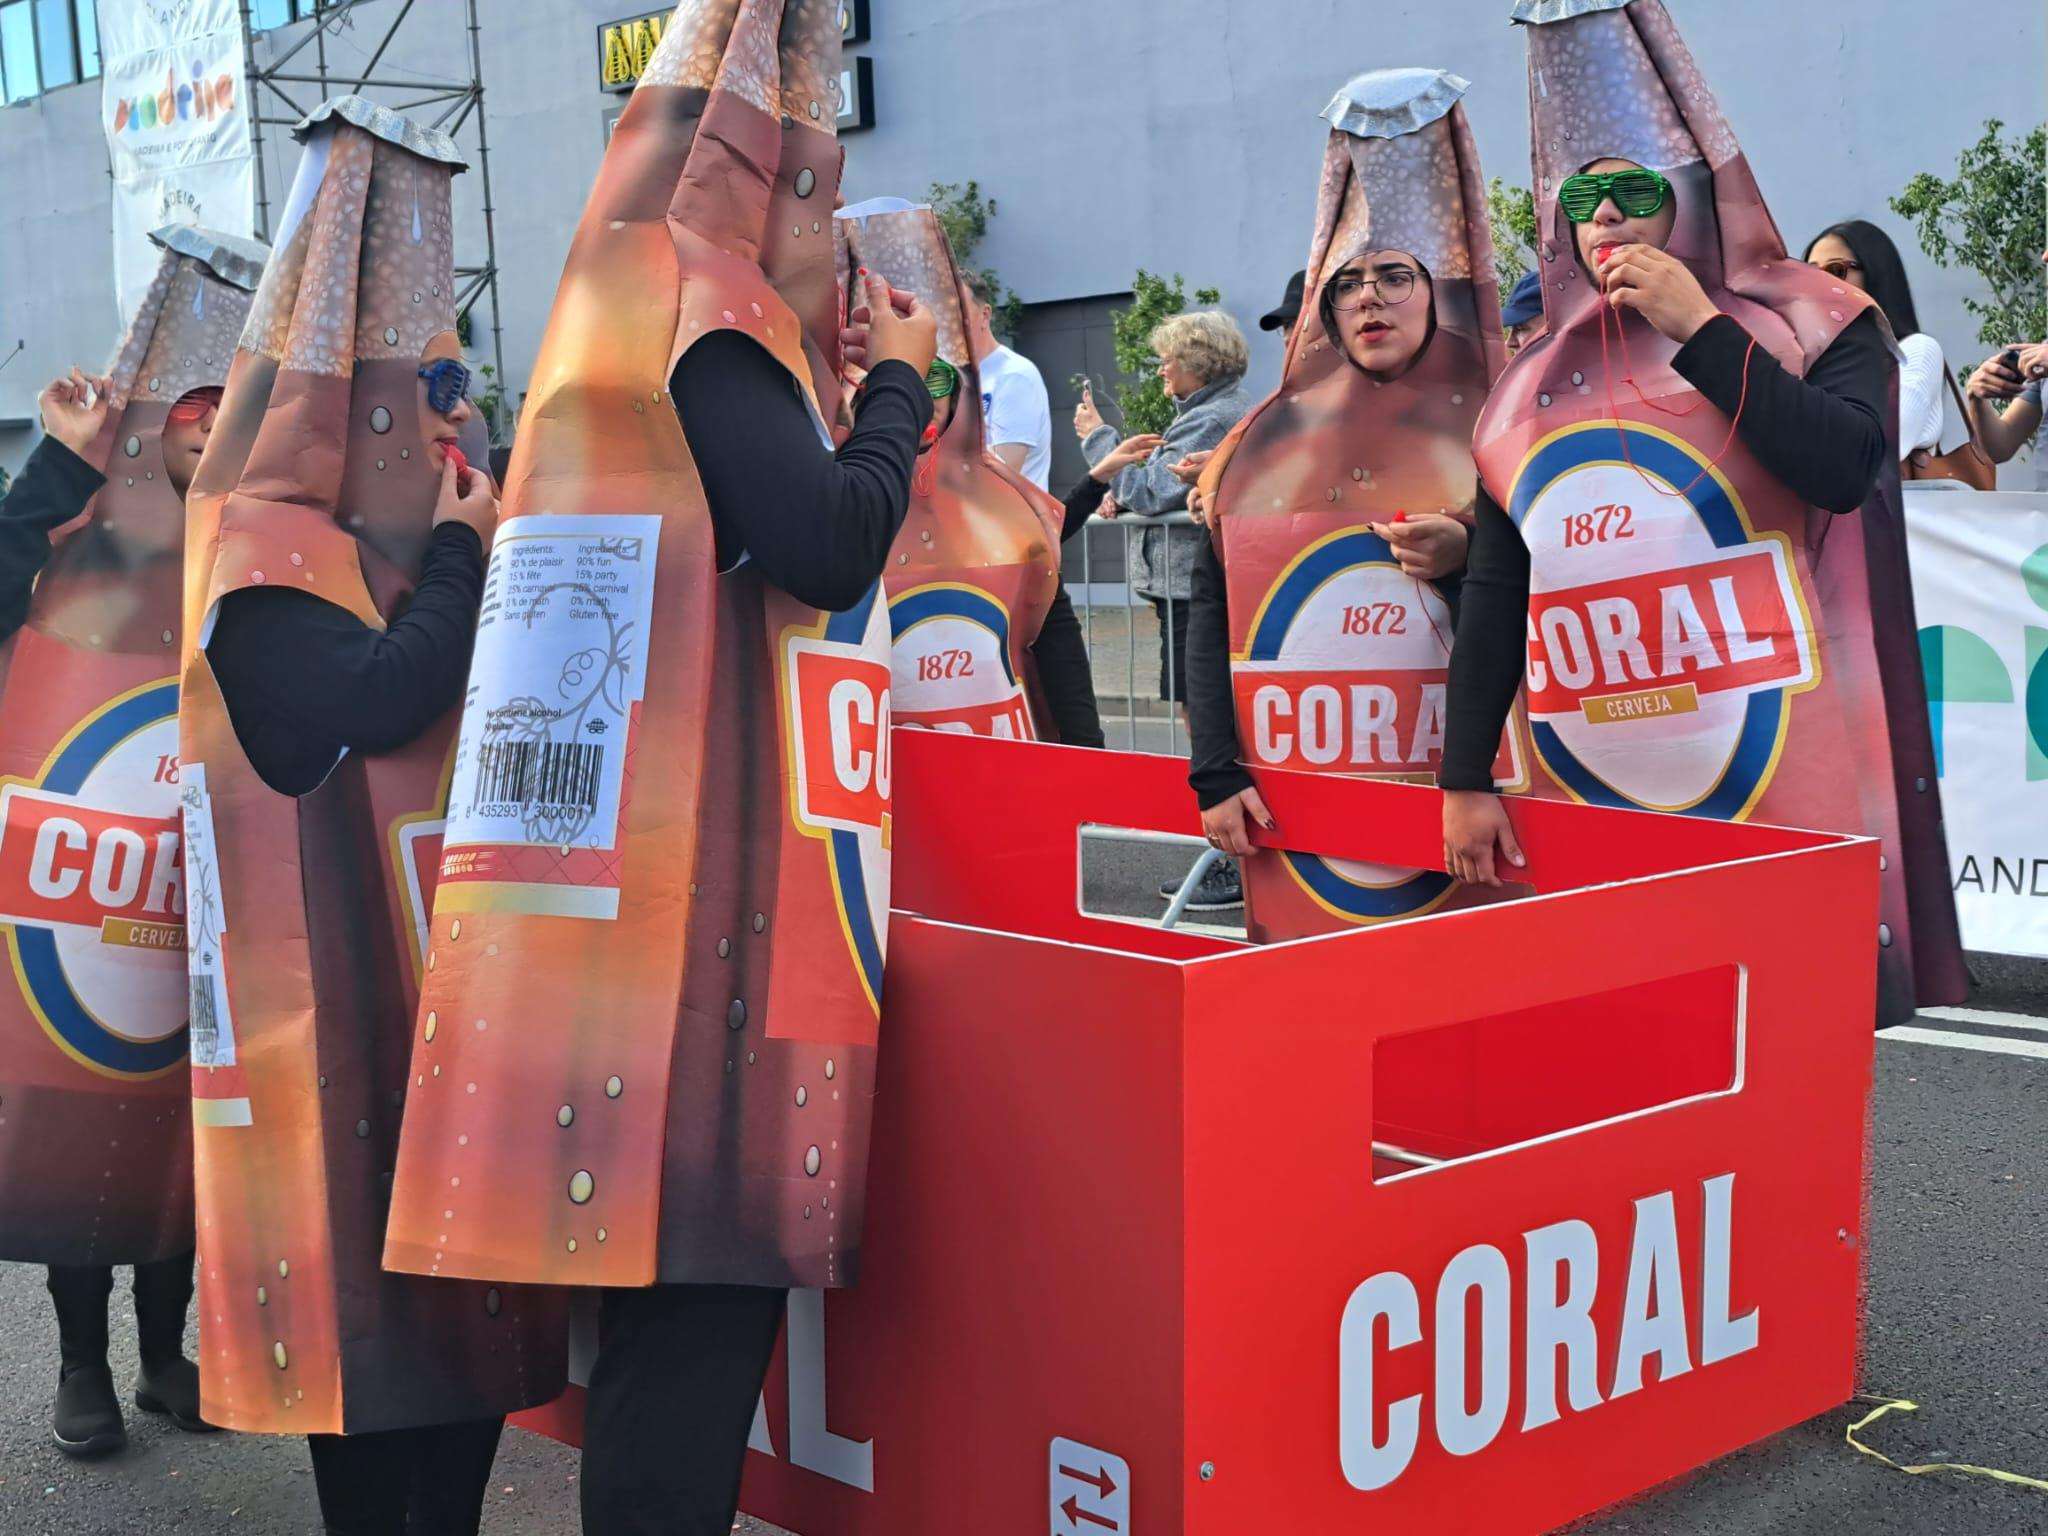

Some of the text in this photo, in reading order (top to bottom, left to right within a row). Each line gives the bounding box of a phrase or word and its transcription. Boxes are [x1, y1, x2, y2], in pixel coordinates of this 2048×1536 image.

[1561, 504, 1635, 548] 1872
[597, 557, 612, 566] fun
[575, 570, 618, 582] 15% party
[593, 584, 629, 594] carnival
[569, 609, 599, 620] Gluten
[1341, 602, 1407, 636] 1872
[916, 648, 975, 681] 1872
[1606, 694, 1673, 718] CERVEJA
[1253, 683, 1447, 765] CORA
[153, 754, 180, 785] 18
[478, 804, 519, 818] 435293
[534, 805, 584, 820] 300001
[28, 816, 184, 916] COR
[128, 926, 185, 948] CERVEJ
[1339, 1172, 1760, 1491] CORAL
